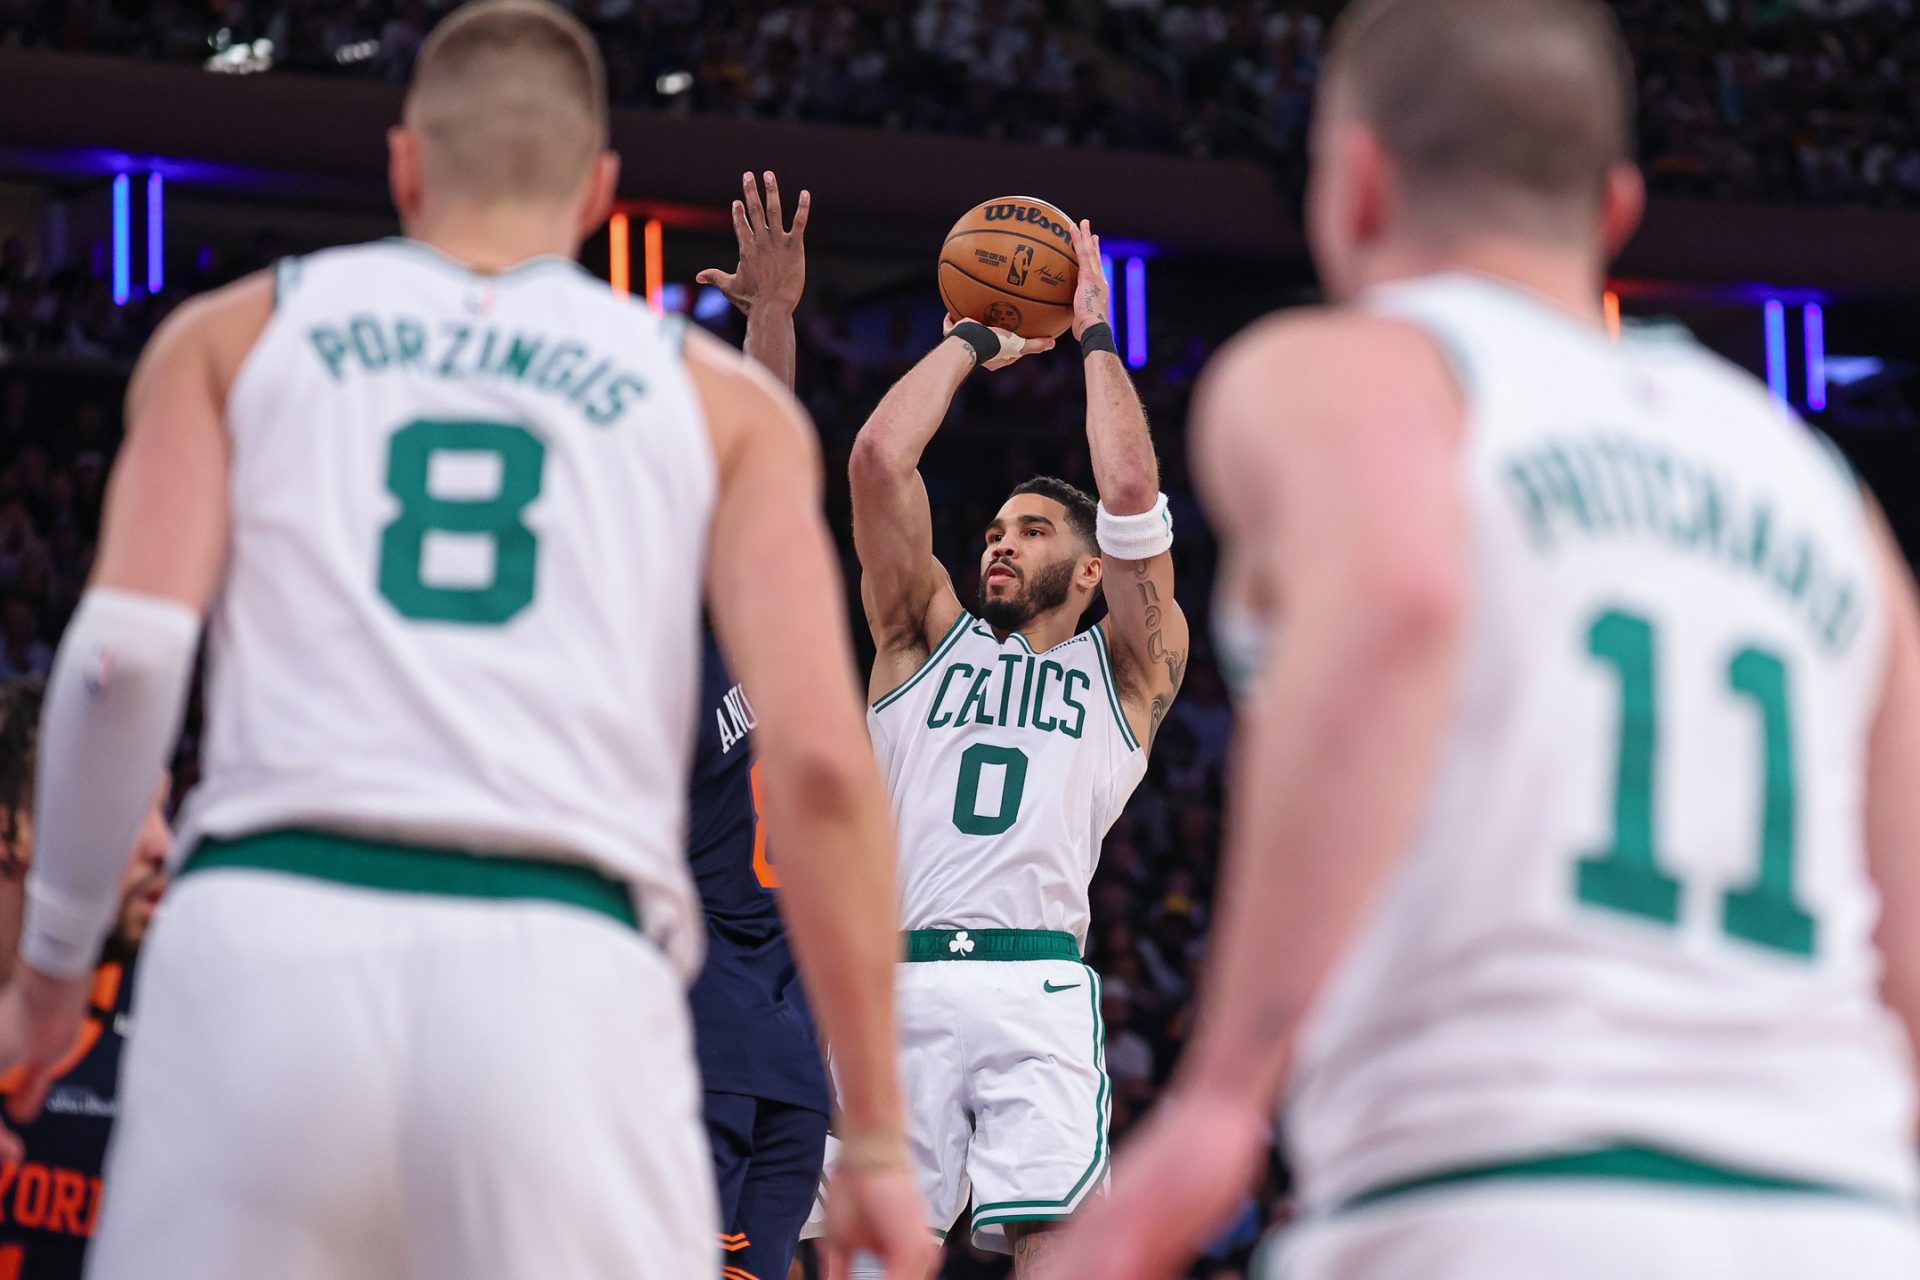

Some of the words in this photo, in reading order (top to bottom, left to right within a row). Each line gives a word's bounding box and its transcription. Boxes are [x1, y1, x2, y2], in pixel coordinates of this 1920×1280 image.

[309, 314, 649, 428] PORZINGIS
[374, 417, 551, 630] 8
[1135, 560, 1166, 665] Deuc
[952, 742, 1029, 837] 0
[1572, 606, 1818, 963] 11
